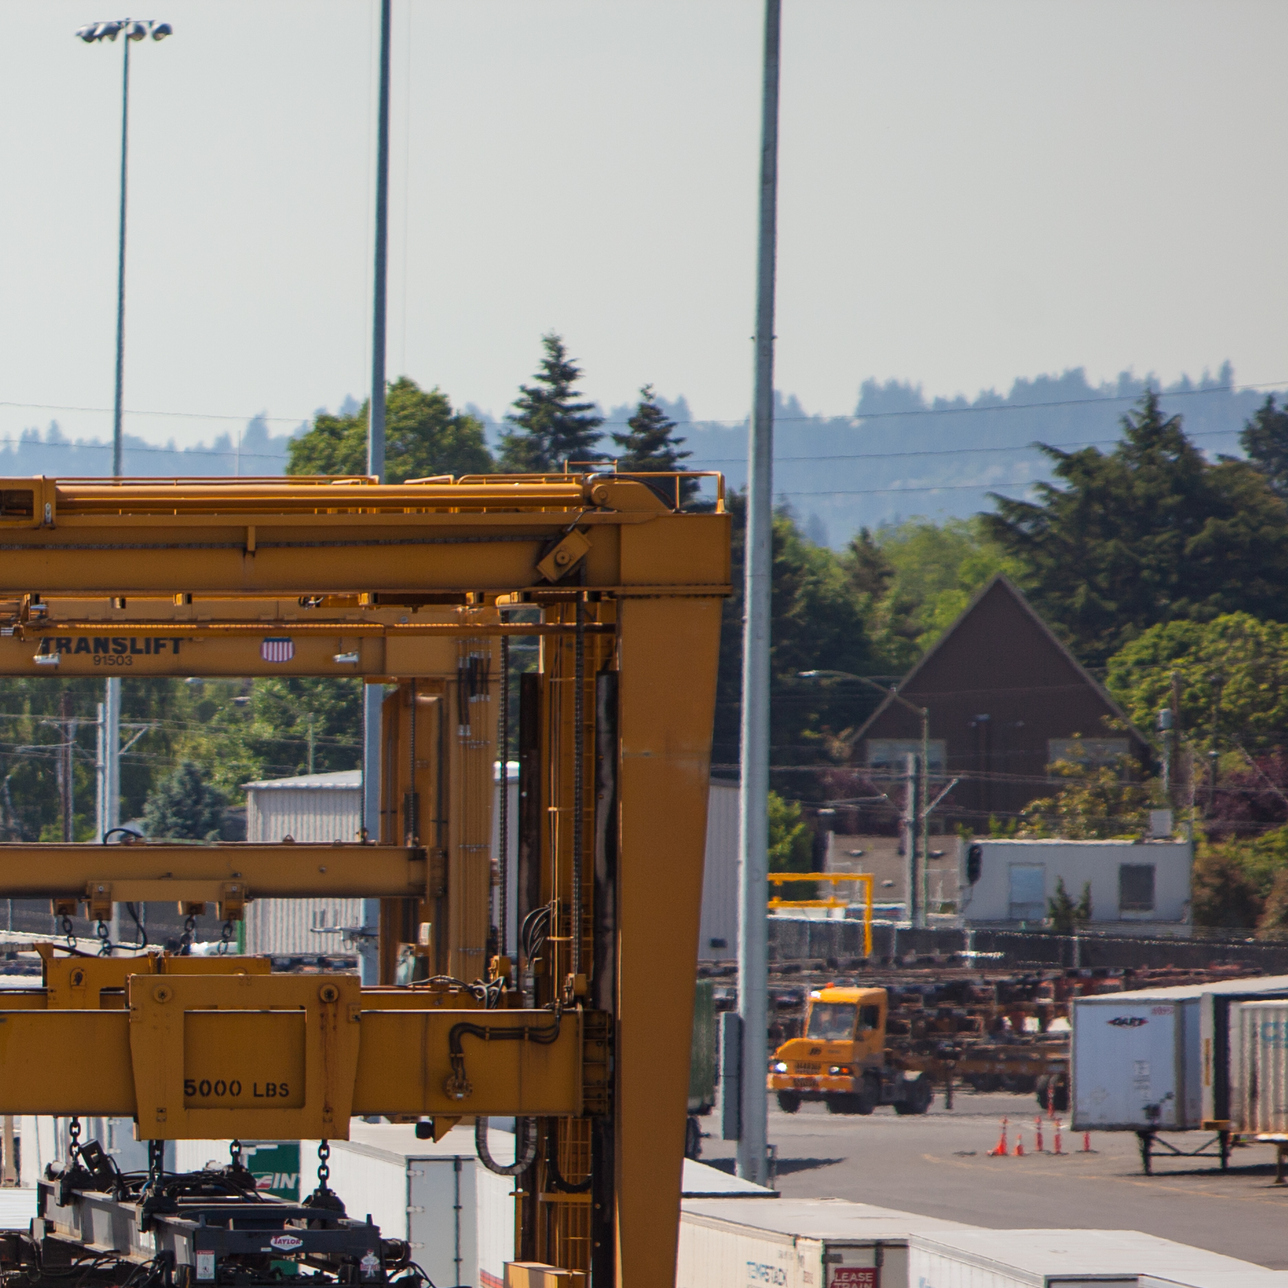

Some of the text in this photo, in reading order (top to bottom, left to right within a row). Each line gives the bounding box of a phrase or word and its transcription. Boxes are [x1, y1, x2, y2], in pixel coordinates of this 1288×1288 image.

[41, 637, 184, 655] TRANSLIFT
[93, 656, 133, 666] 91503
[183, 1078, 289, 1099] 5000 LBS
[272, 1235, 302, 1246] TAYLOR
[834, 1272, 874, 1282] LEASE
